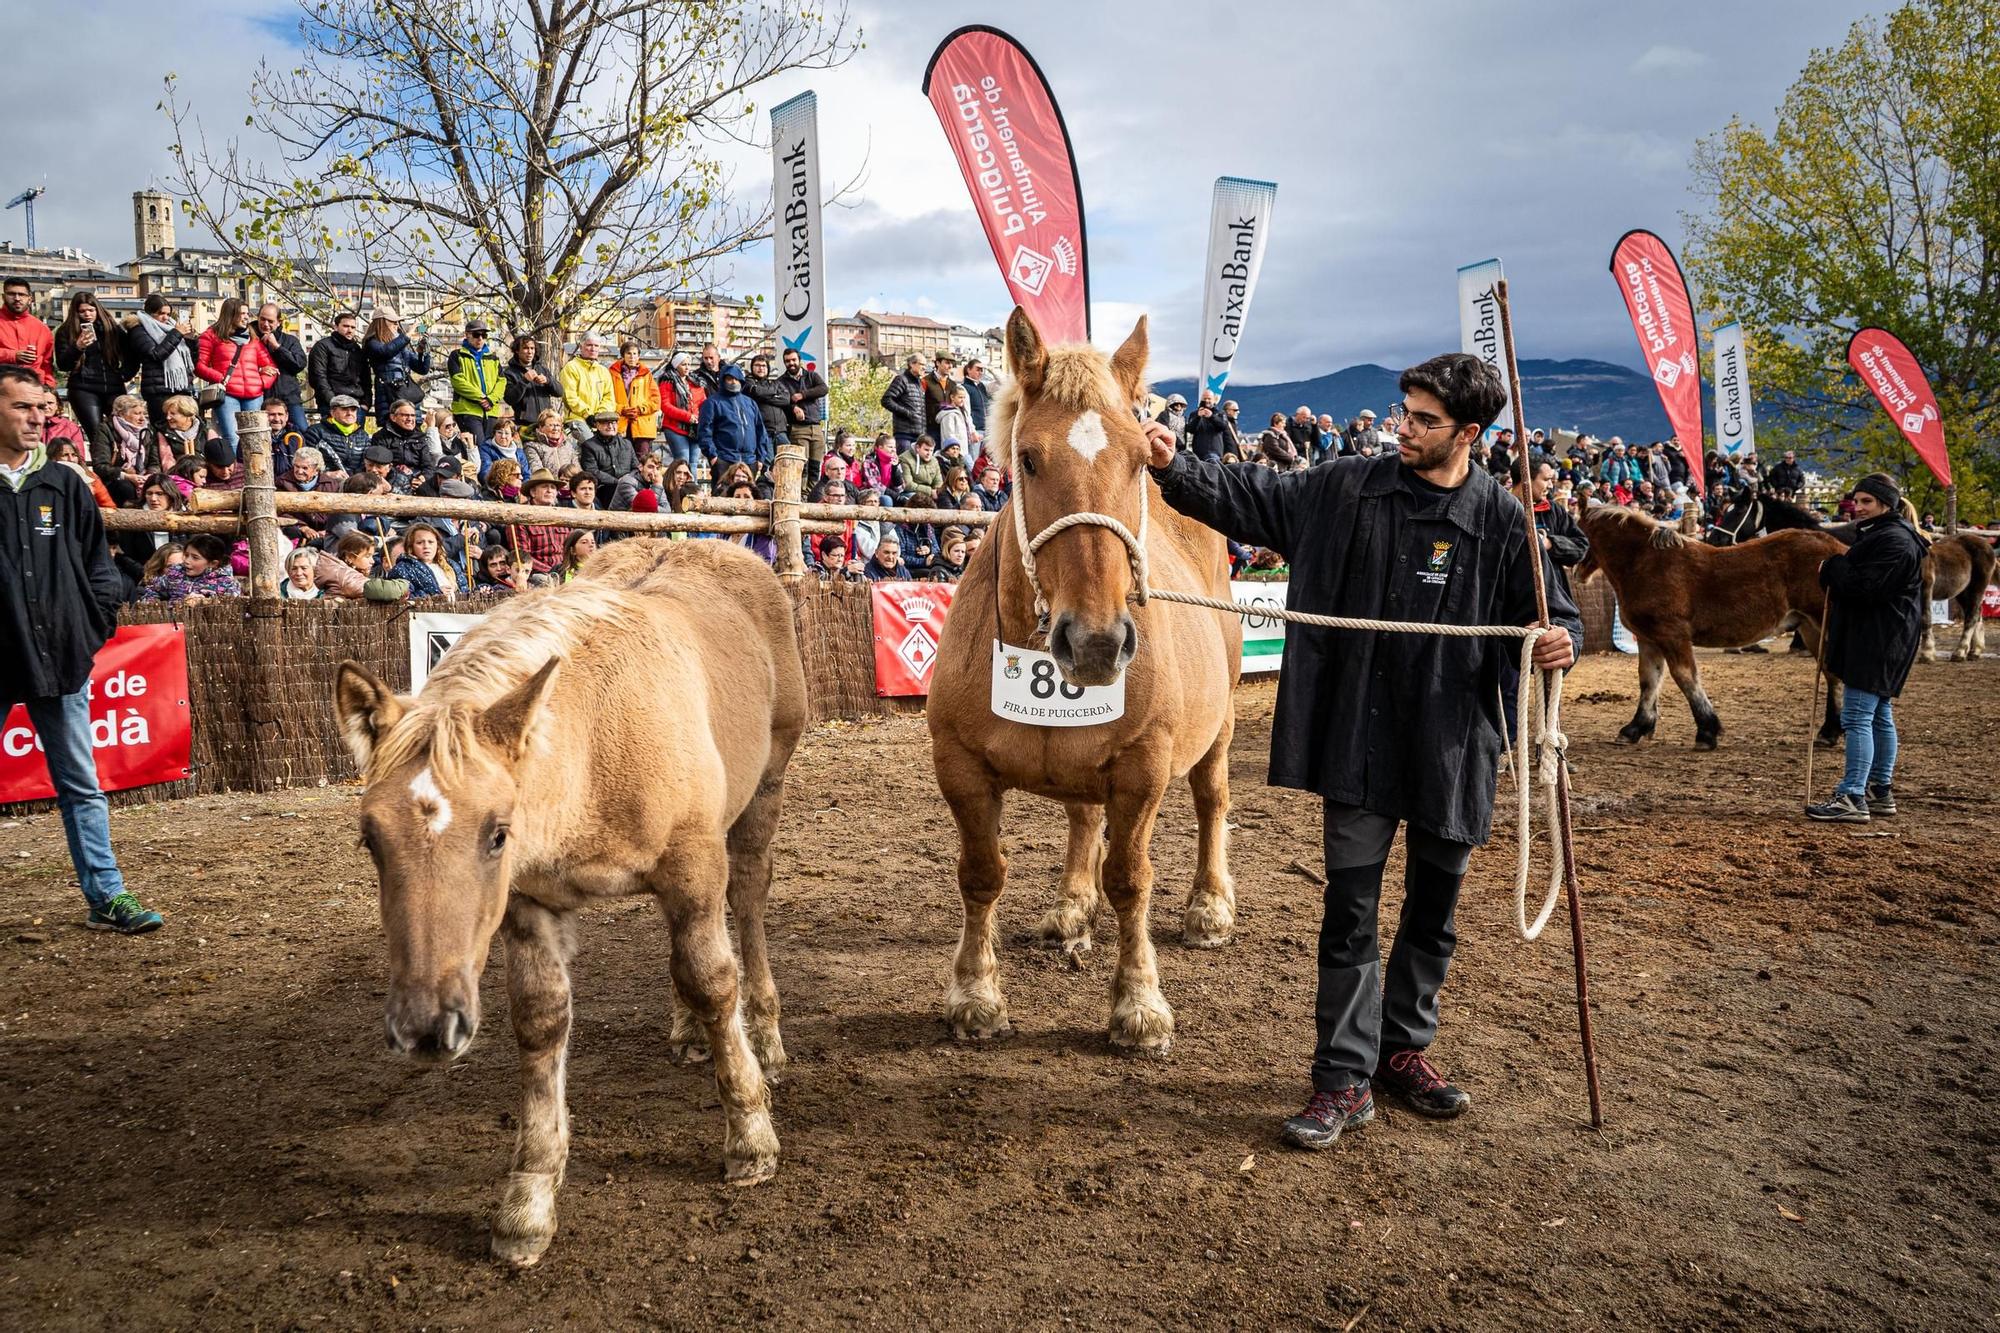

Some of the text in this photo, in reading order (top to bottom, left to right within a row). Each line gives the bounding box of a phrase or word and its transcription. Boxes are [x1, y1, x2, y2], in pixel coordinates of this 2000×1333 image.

[782, 136, 811, 322] CaixaBank
[1213, 215, 1256, 363] CaixaBank
[1722, 344, 1742, 437] CaixaBank
[104, 670, 147, 699] de
[1003, 701, 1113, 718] FIRA DE PUIGCERDÀ
